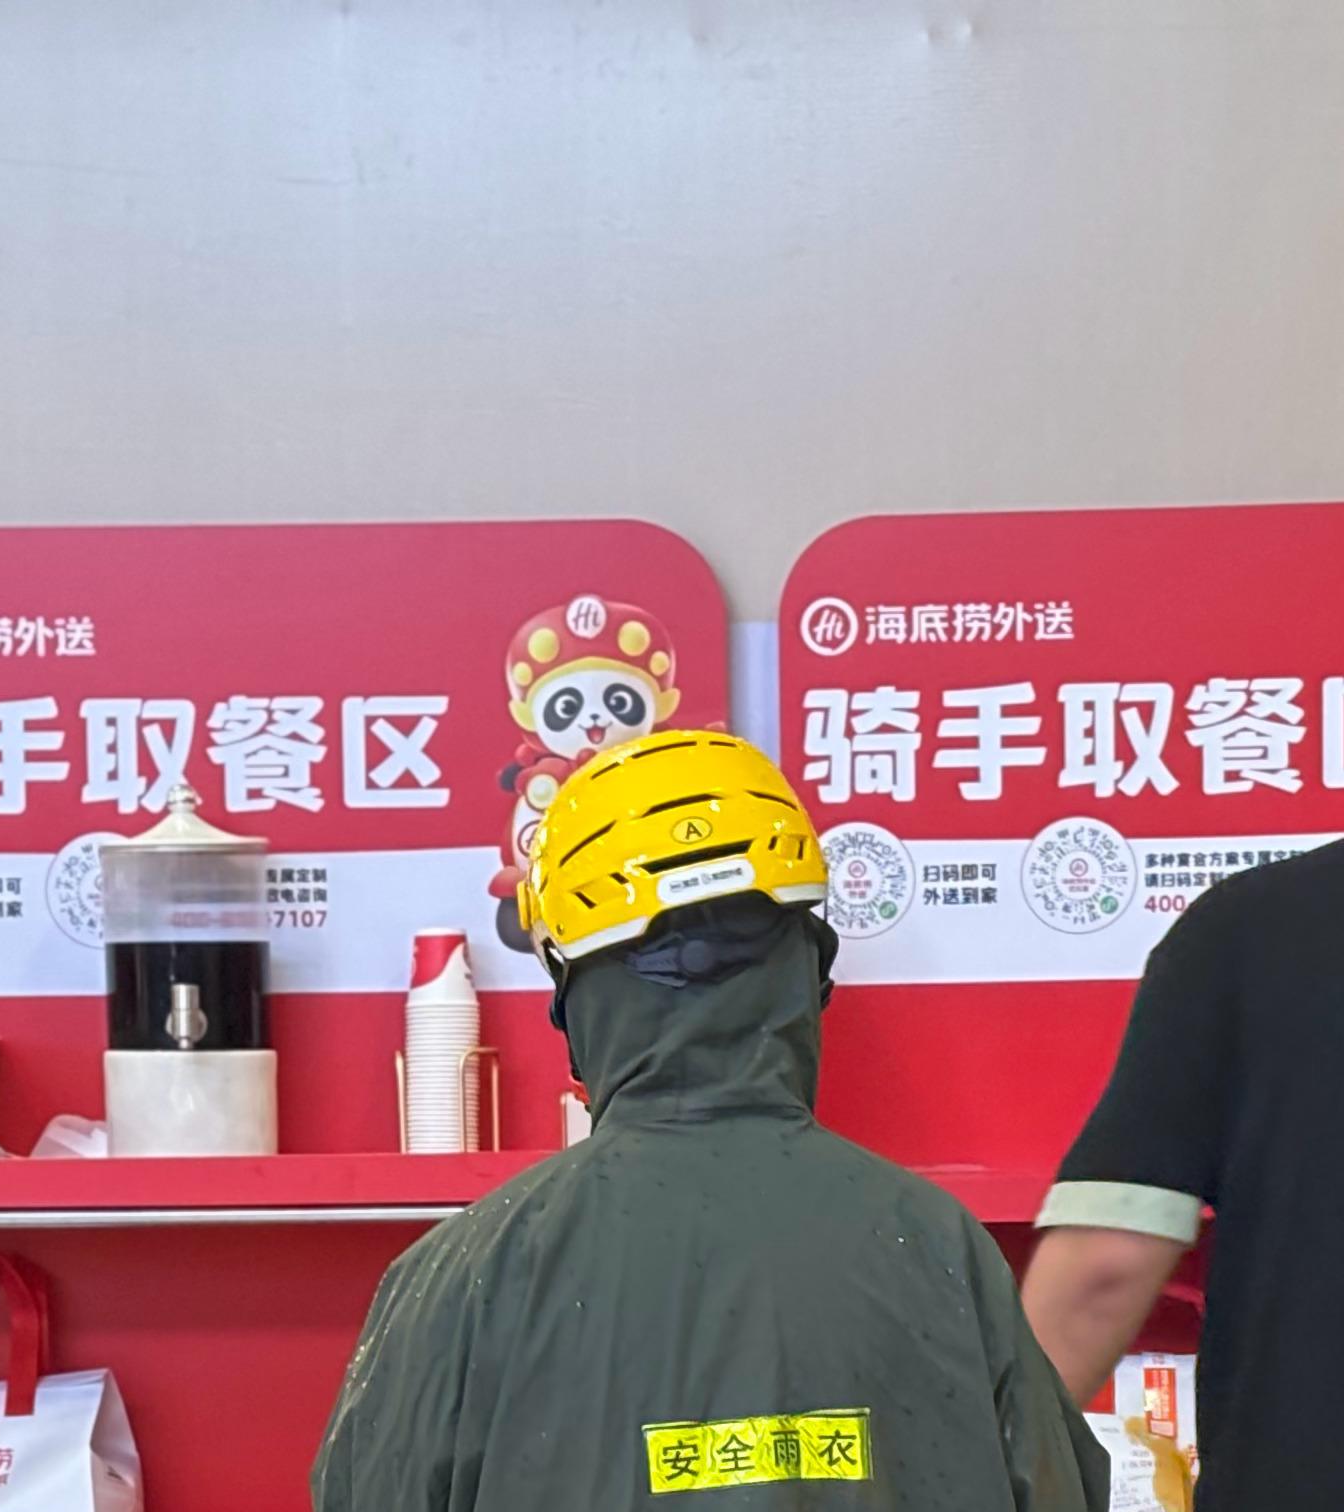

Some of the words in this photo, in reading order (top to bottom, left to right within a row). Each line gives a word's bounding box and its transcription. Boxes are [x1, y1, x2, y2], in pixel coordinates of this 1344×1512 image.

[865, 601, 1075, 645] 海底捞外送
[685, 821, 703, 840] A
[922, 863, 998, 883] 扫码即可
[923, 886, 998, 906] 外送到家
[661, 1428, 859, 1481] 安全雨衣
